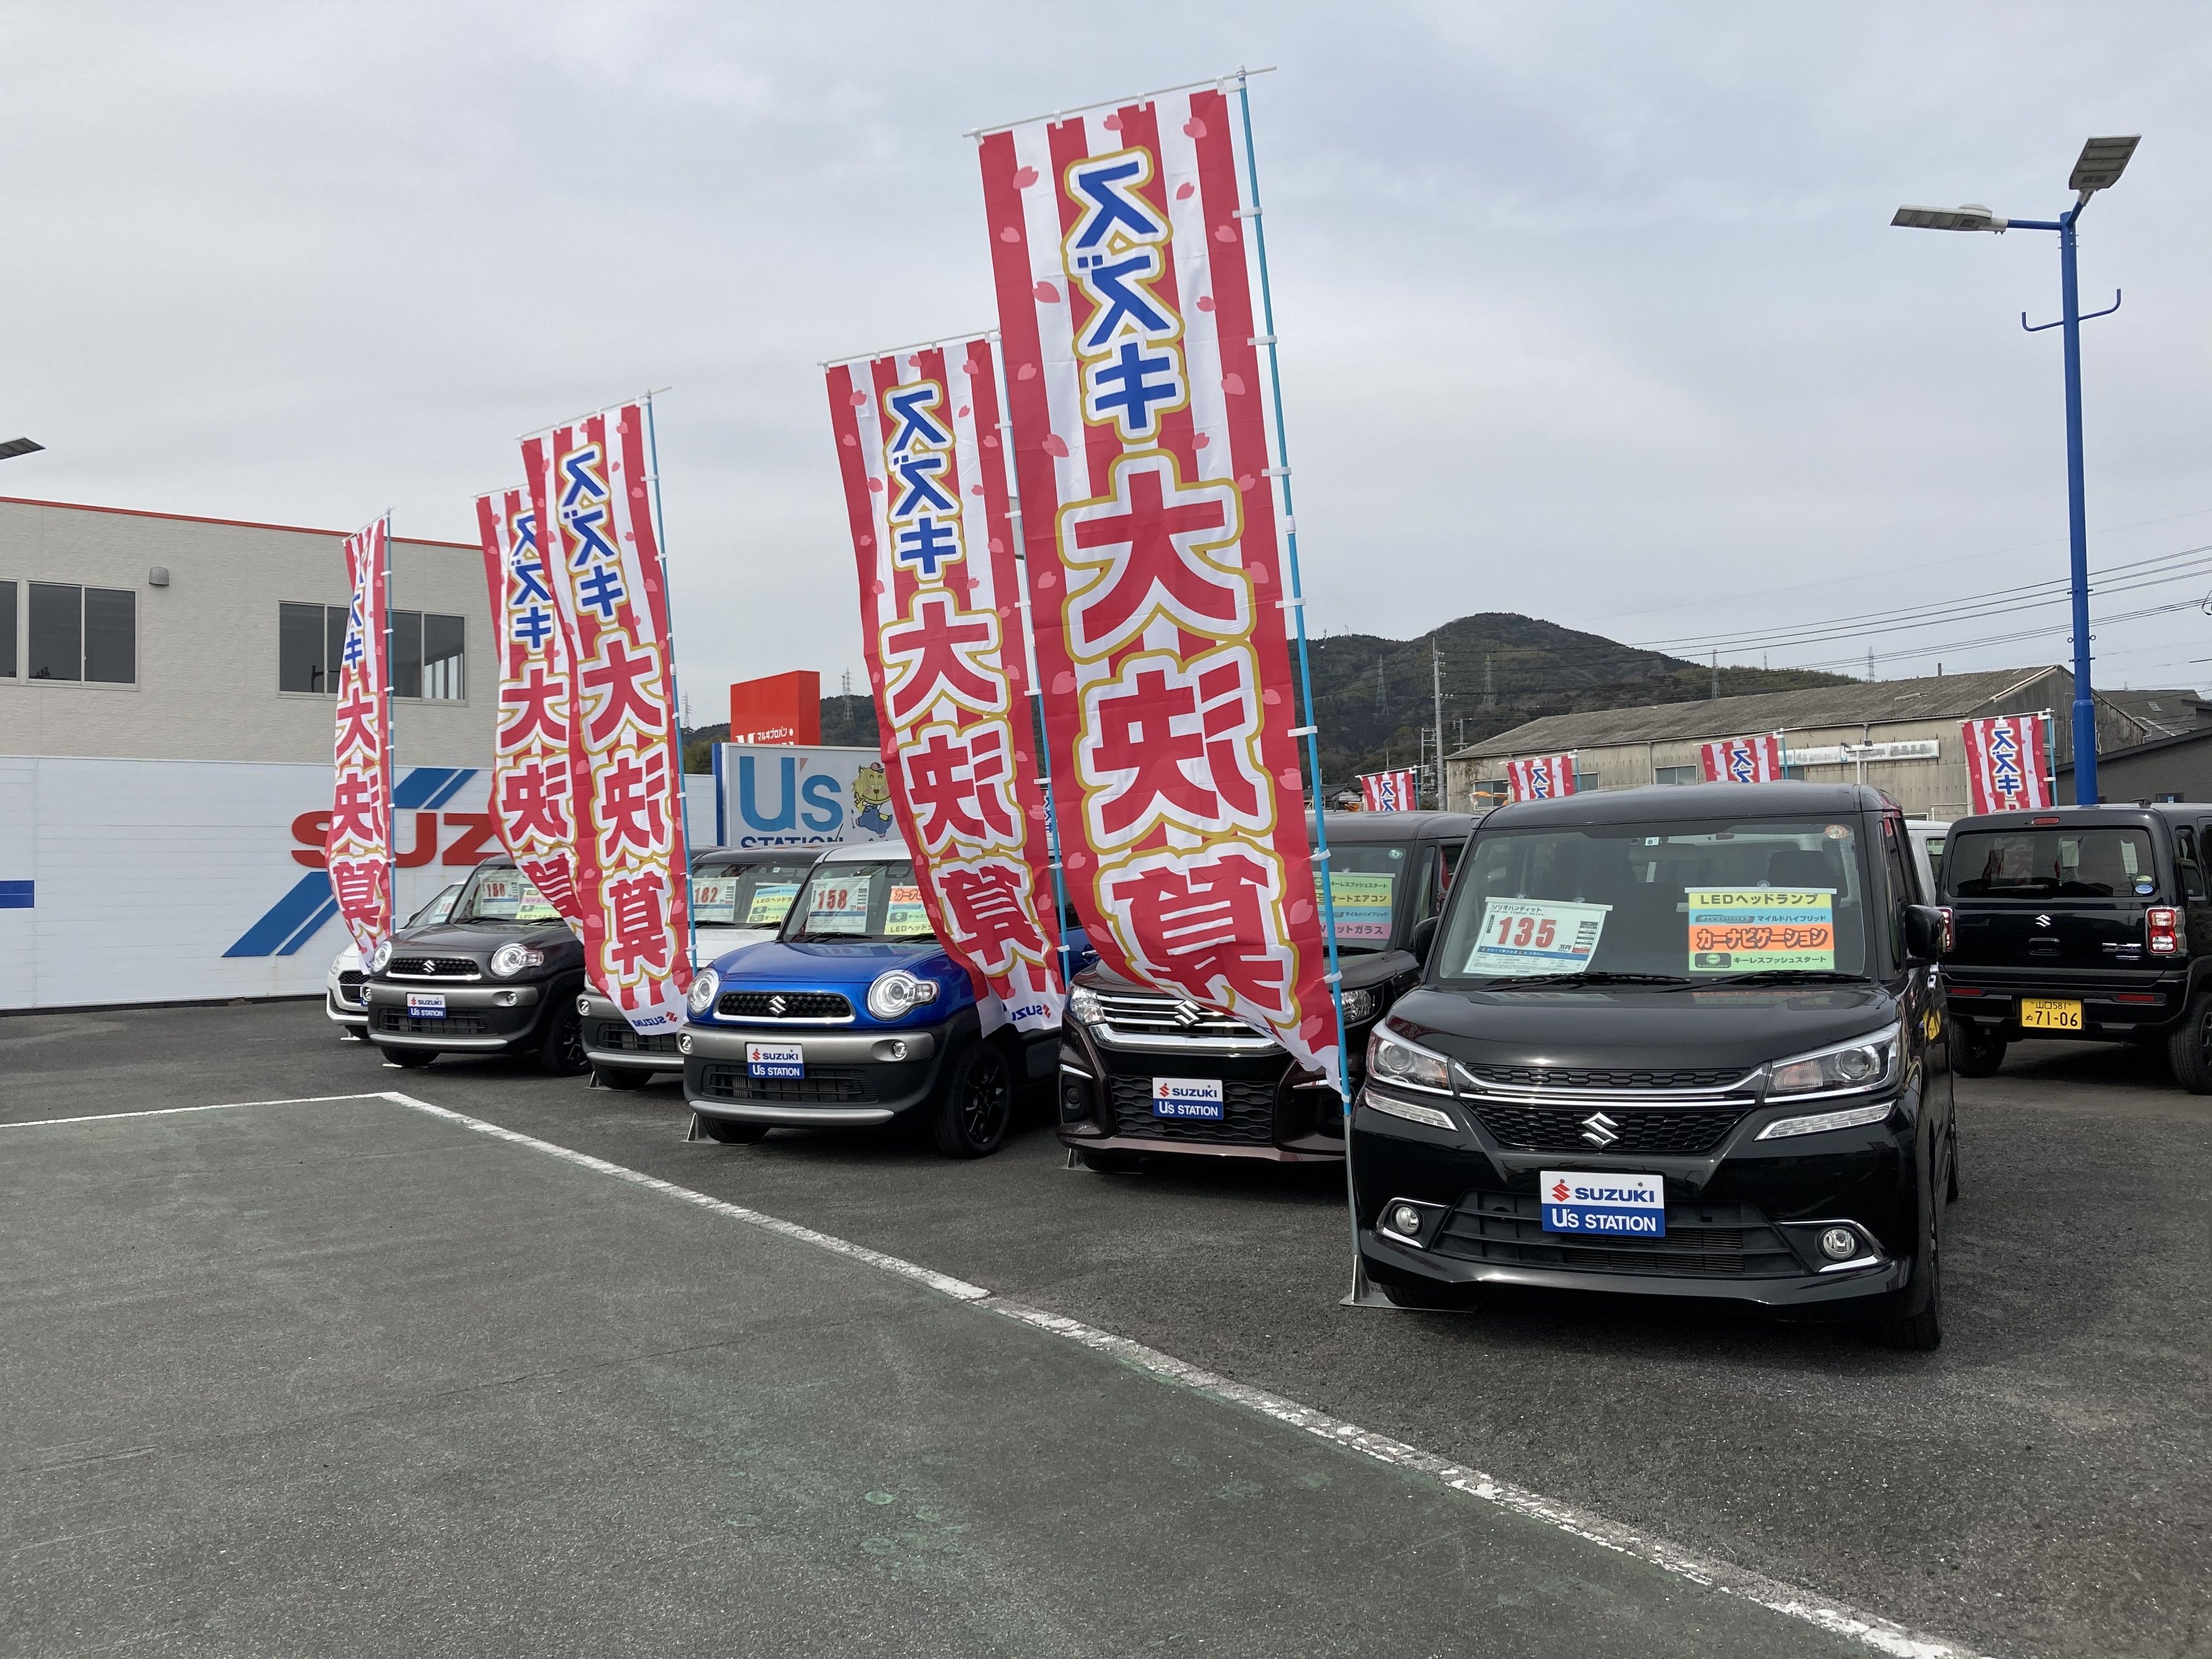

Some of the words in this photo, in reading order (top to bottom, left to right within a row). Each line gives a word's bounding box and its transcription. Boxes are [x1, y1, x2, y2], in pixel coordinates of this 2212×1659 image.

[740, 756, 843, 832] U's
[818, 889, 848, 910] 158
[1701, 894, 1818, 905] LEDヘッドランプ
[1492, 904, 1542, 913] ソリオバンディット
[1497, 916, 1558, 949] 135
[1697, 927, 1828, 950] カーナビゲーション
[2035, 1011, 2078, 1027] 71-06
[752, 1064, 765, 1075] U's
[768, 1067, 800, 1076] STATION
[1172, 1088, 1217, 1098] SUZUKI
[1159, 1101, 1175, 1114] U's
[1178, 1105, 1218, 1116] STATION
[1575, 1187, 1654, 1203] SUZUKI
[1551, 1208, 1579, 1228] U's
[1585, 1214, 1656, 1232] STATION
